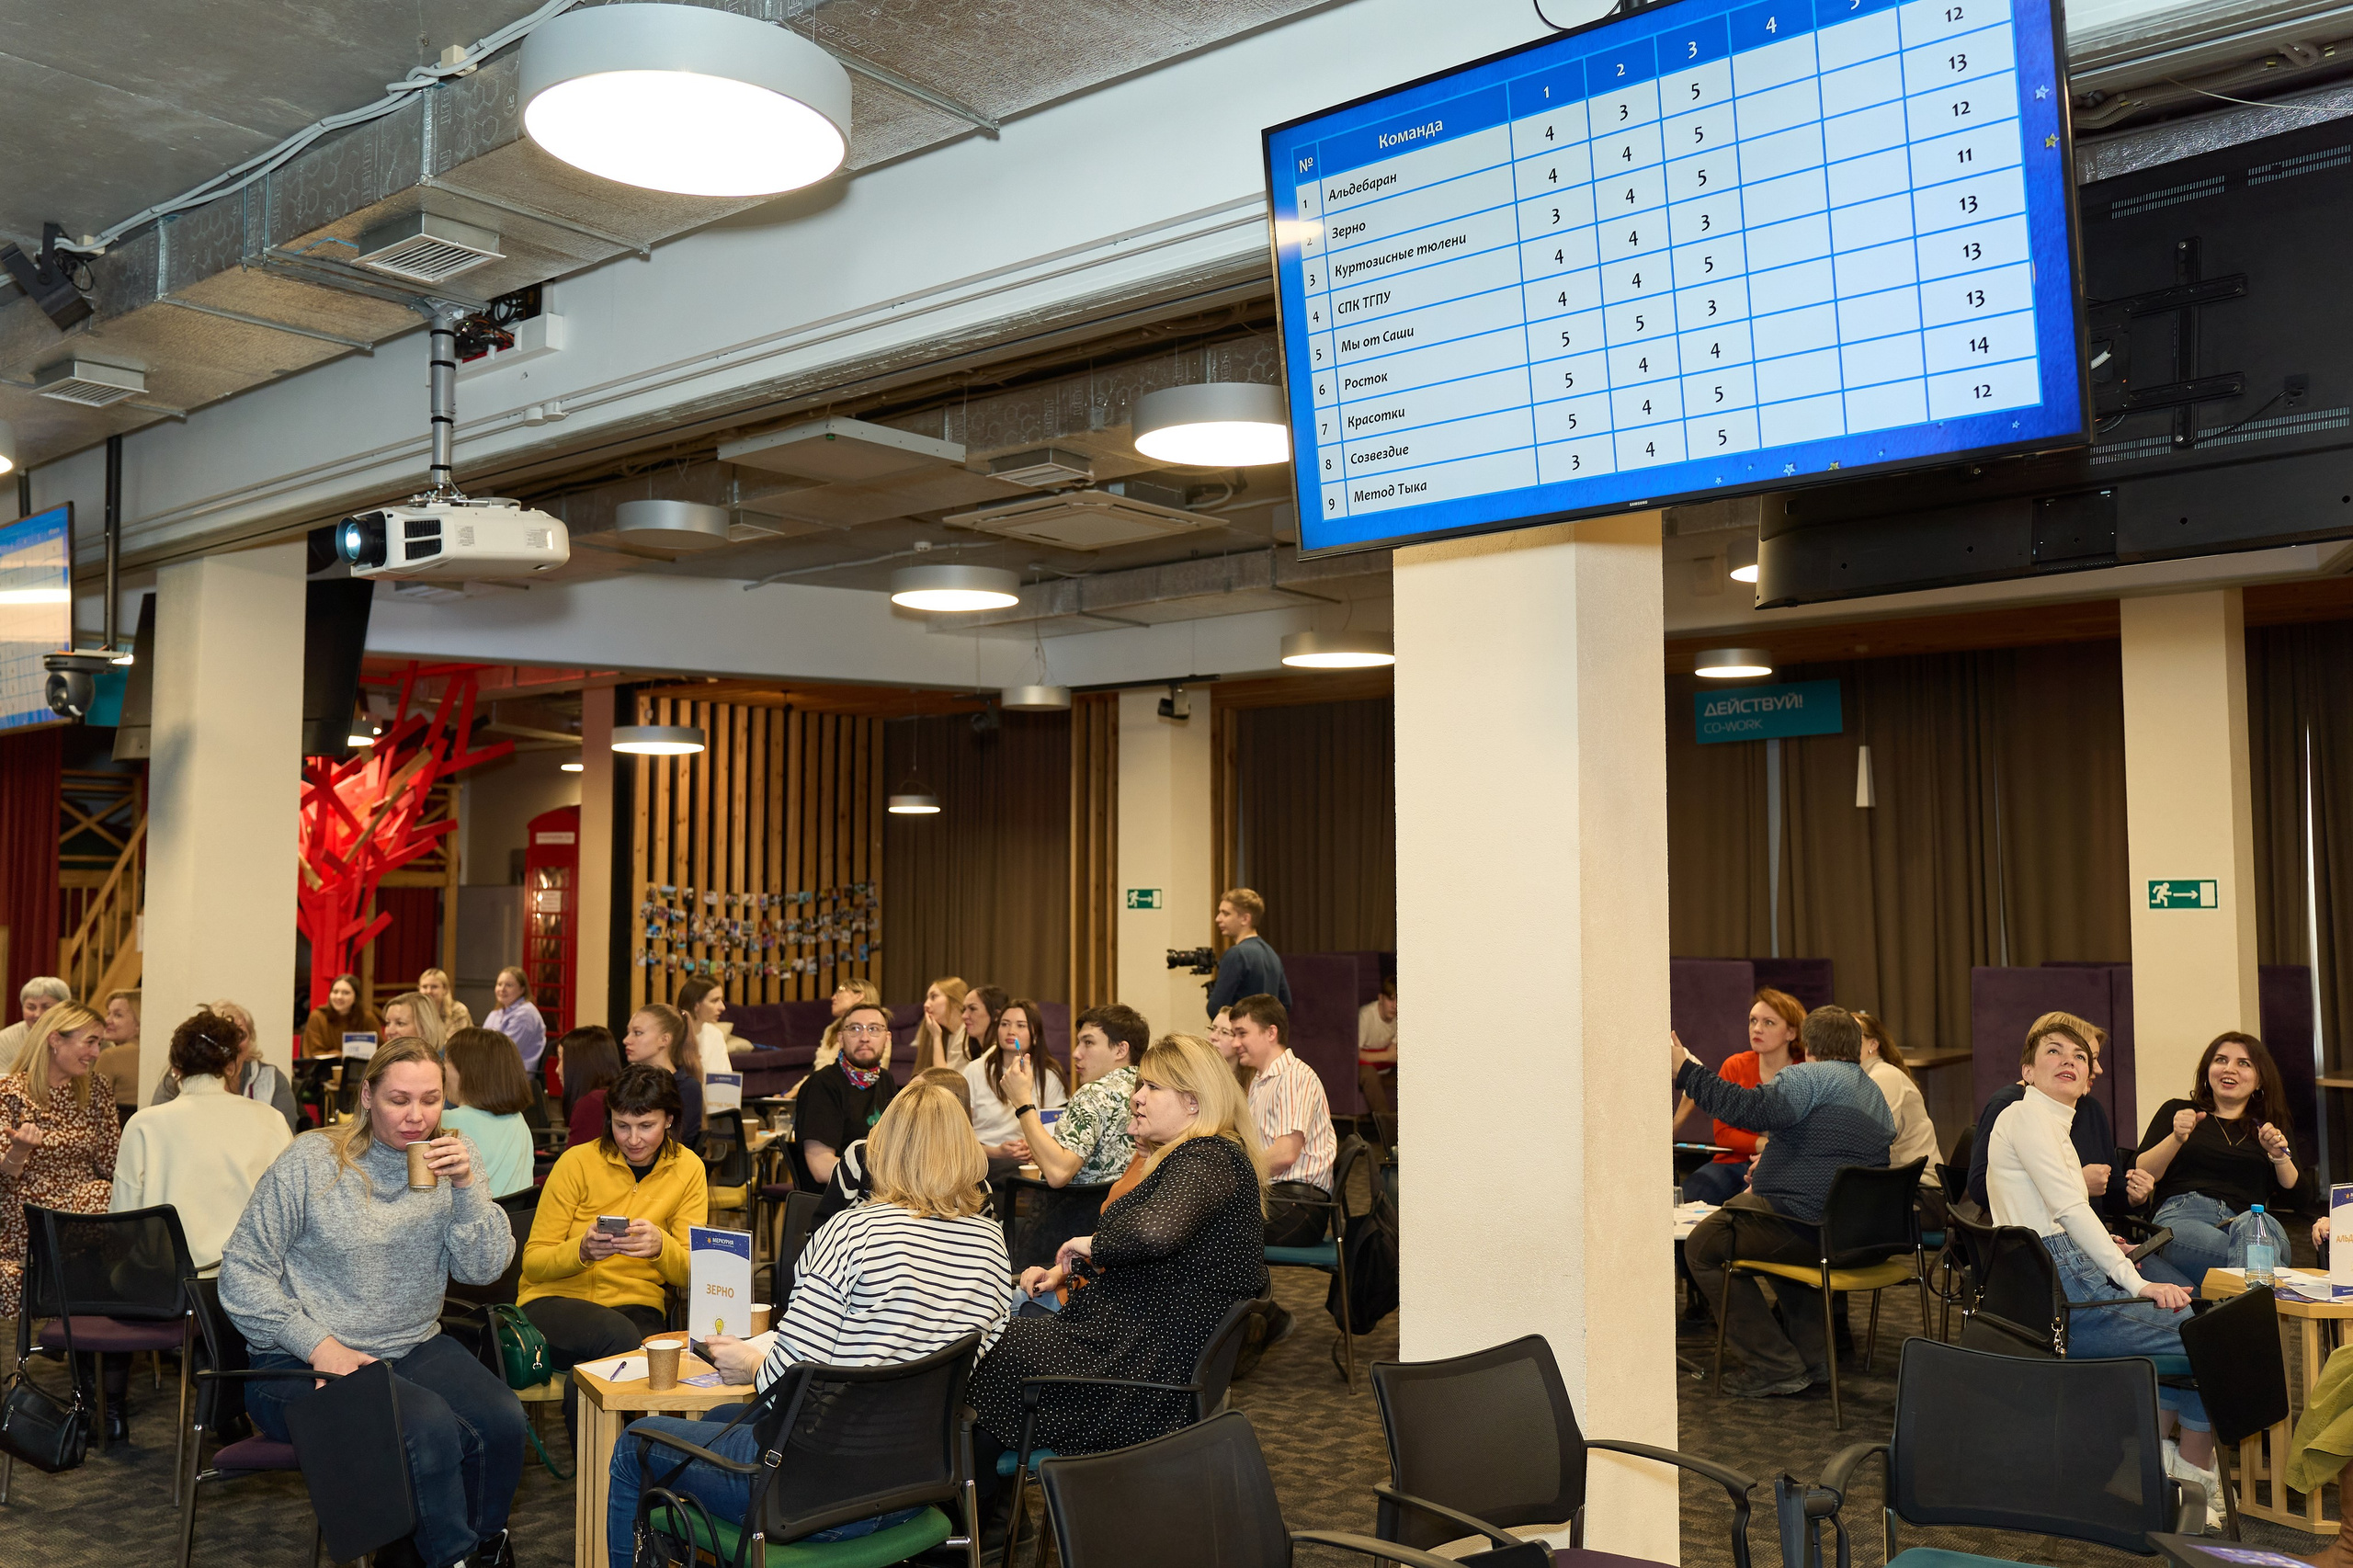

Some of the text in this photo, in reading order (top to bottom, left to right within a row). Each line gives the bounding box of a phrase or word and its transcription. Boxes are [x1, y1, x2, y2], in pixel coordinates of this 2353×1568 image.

[1298, 156, 1313, 174] №
[1379, 120, 1443, 149] Команда
[1542, 85, 1551, 99] 1
[1616, 63, 1626, 77] 2
[1688, 41, 1698, 59] 3
[1765, 16, 1778, 34] 4
[1301, 6, 1964, 210] 1 Альдебаран 4 3 5 12
[1306, 53, 1968, 246] 2 Зерно 4 4 5 13
[1309, 101, 1971, 288] 3 Куртозисные тюлени 3 4 5 12
[1313, 147, 1972, 324] 4 СПК ТГПУ 4 4 3 11
[1315, 195, 1978, 361] 5 Мы от Саши 4 4 5 13
[1318, 242, 1982, 396] 6 Росток 5 5 3 13
[1321, 290, 1985, 436] 7 Красотки 5 4 4 13
[1324, 336, 1990, 471] 8 Созвездие 5 4 5 14
[1328, 384, 1993, 511] 9 Метод Тыка 3 4 5 12
[1703, 692, 1803, 717] ДЕЙСТВУЙ!
[1703, 719, 1763, 734] CO-WORK
[706, 1283, 734, 1299] ЗЕРНО
